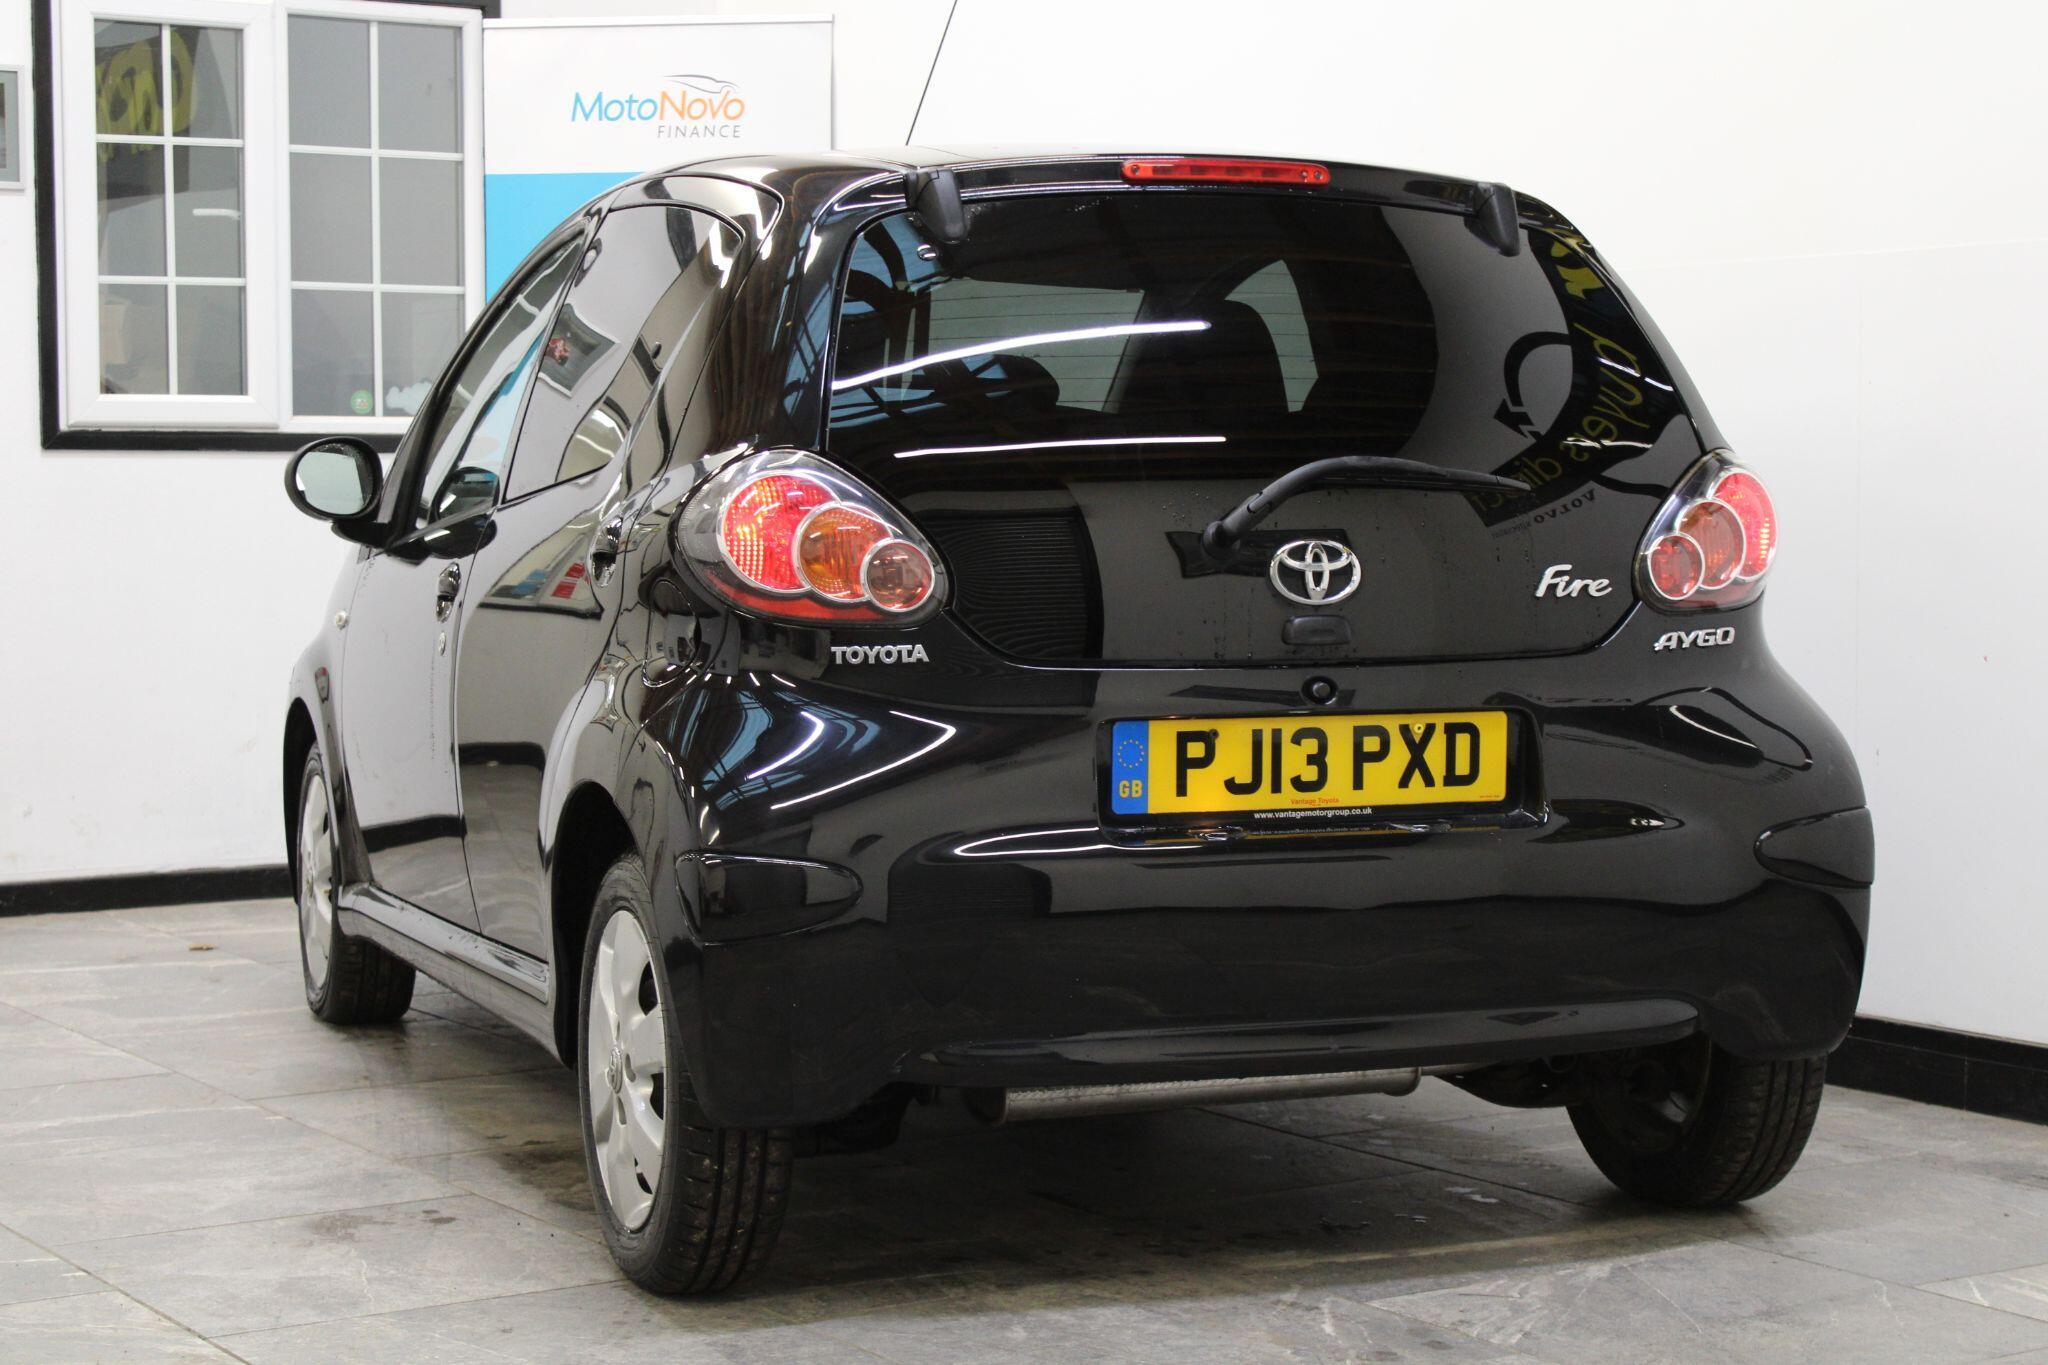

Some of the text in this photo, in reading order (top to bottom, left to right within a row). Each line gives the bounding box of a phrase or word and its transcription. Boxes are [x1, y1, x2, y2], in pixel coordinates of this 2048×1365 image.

[571, 90, 745, 122] MotoNovo
[657, 125, 742, 138] FINANCE
[1535, 564, 1613, 598] Fire
[1654, 626, 1736, 651] AYGO
[830, 644, 930, 665] TOYOTA
[1175, 721, 1481, 798] PJ13 PXD
[1119, 780, 1143, 798] GB
[1317, 796, 1340, 805] Toyota
[1254, 807, 1373, 820] www.vantagemotorgroup.co.uk
